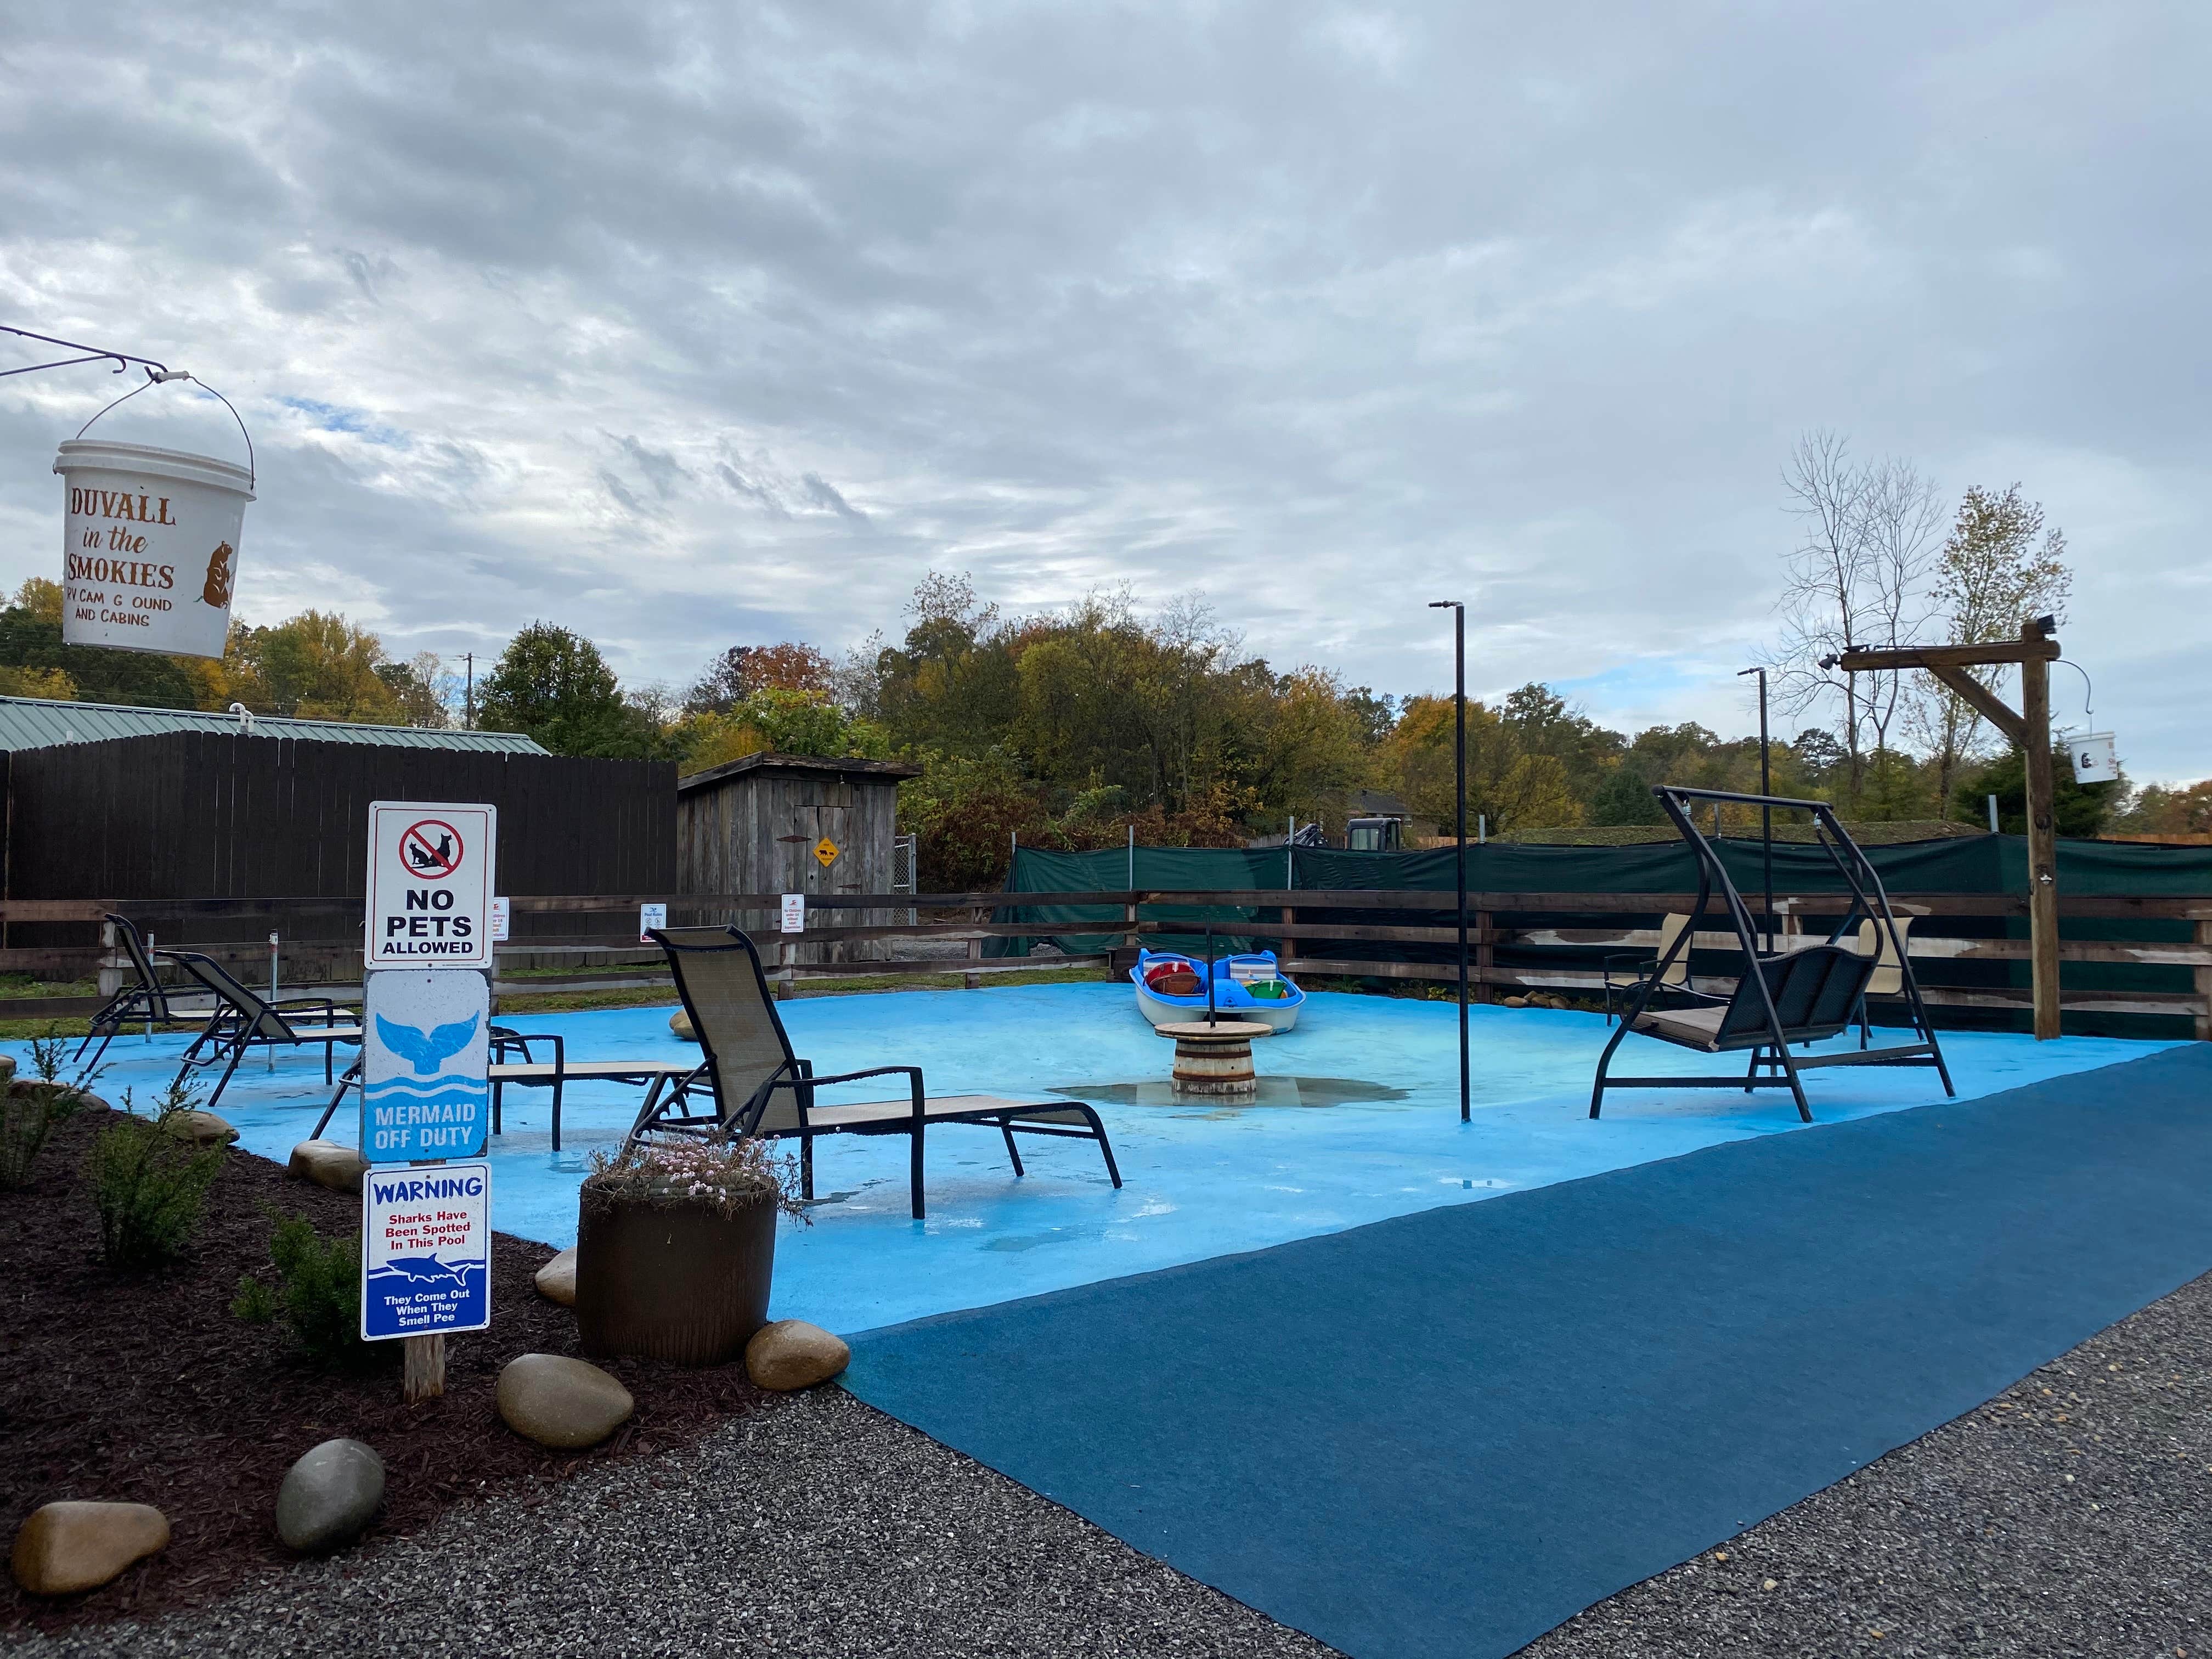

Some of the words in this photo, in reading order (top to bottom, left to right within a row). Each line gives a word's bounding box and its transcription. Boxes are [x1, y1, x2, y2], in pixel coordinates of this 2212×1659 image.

[71, 488, 177, 526] DUVALL
[83, 527, 103, 548] in
[107, 526, 149, 554] the
[68, 553, 174, 589] SMOKIES
[67, 586, 76, 601] RV
[75, 607, 95, 620] AND
[100, 609, 149, 627] CABINS
[407, 889, 454, 910] NO
[387, 916, 471, 937] PETS
[382, 942, 473, 954] ALLOWED
[376, 1103, 476, 1126] MERMAID
[375, 1130, 411, 1149] OFF
[420, 1126, 472, 1147] DUTY
[373, 1177, 483, 1205] WARNING
[389, 1213, 432, 1224] Sharks
[437, 1211, 467, 1221] Have
[386, 1227, 417, 1238] Been
[422, 1222, 471, 1236] Spotted
[391, 1240, 403, 1250] In
[408, 1238, 433, 1249] This
[438, 1235, 465, 1246] Pool
[384, 1295, 411, 1306] They
[415, 1292, 447, 1303] Come
[450, 1289, 470, 1299] Out
[396, 1304, 427, 1316] When
[431, 1302, 458, 1313] They
[398, 1314, 430, 1327] Smell
[434, 1313, 455, 1323] Pee
